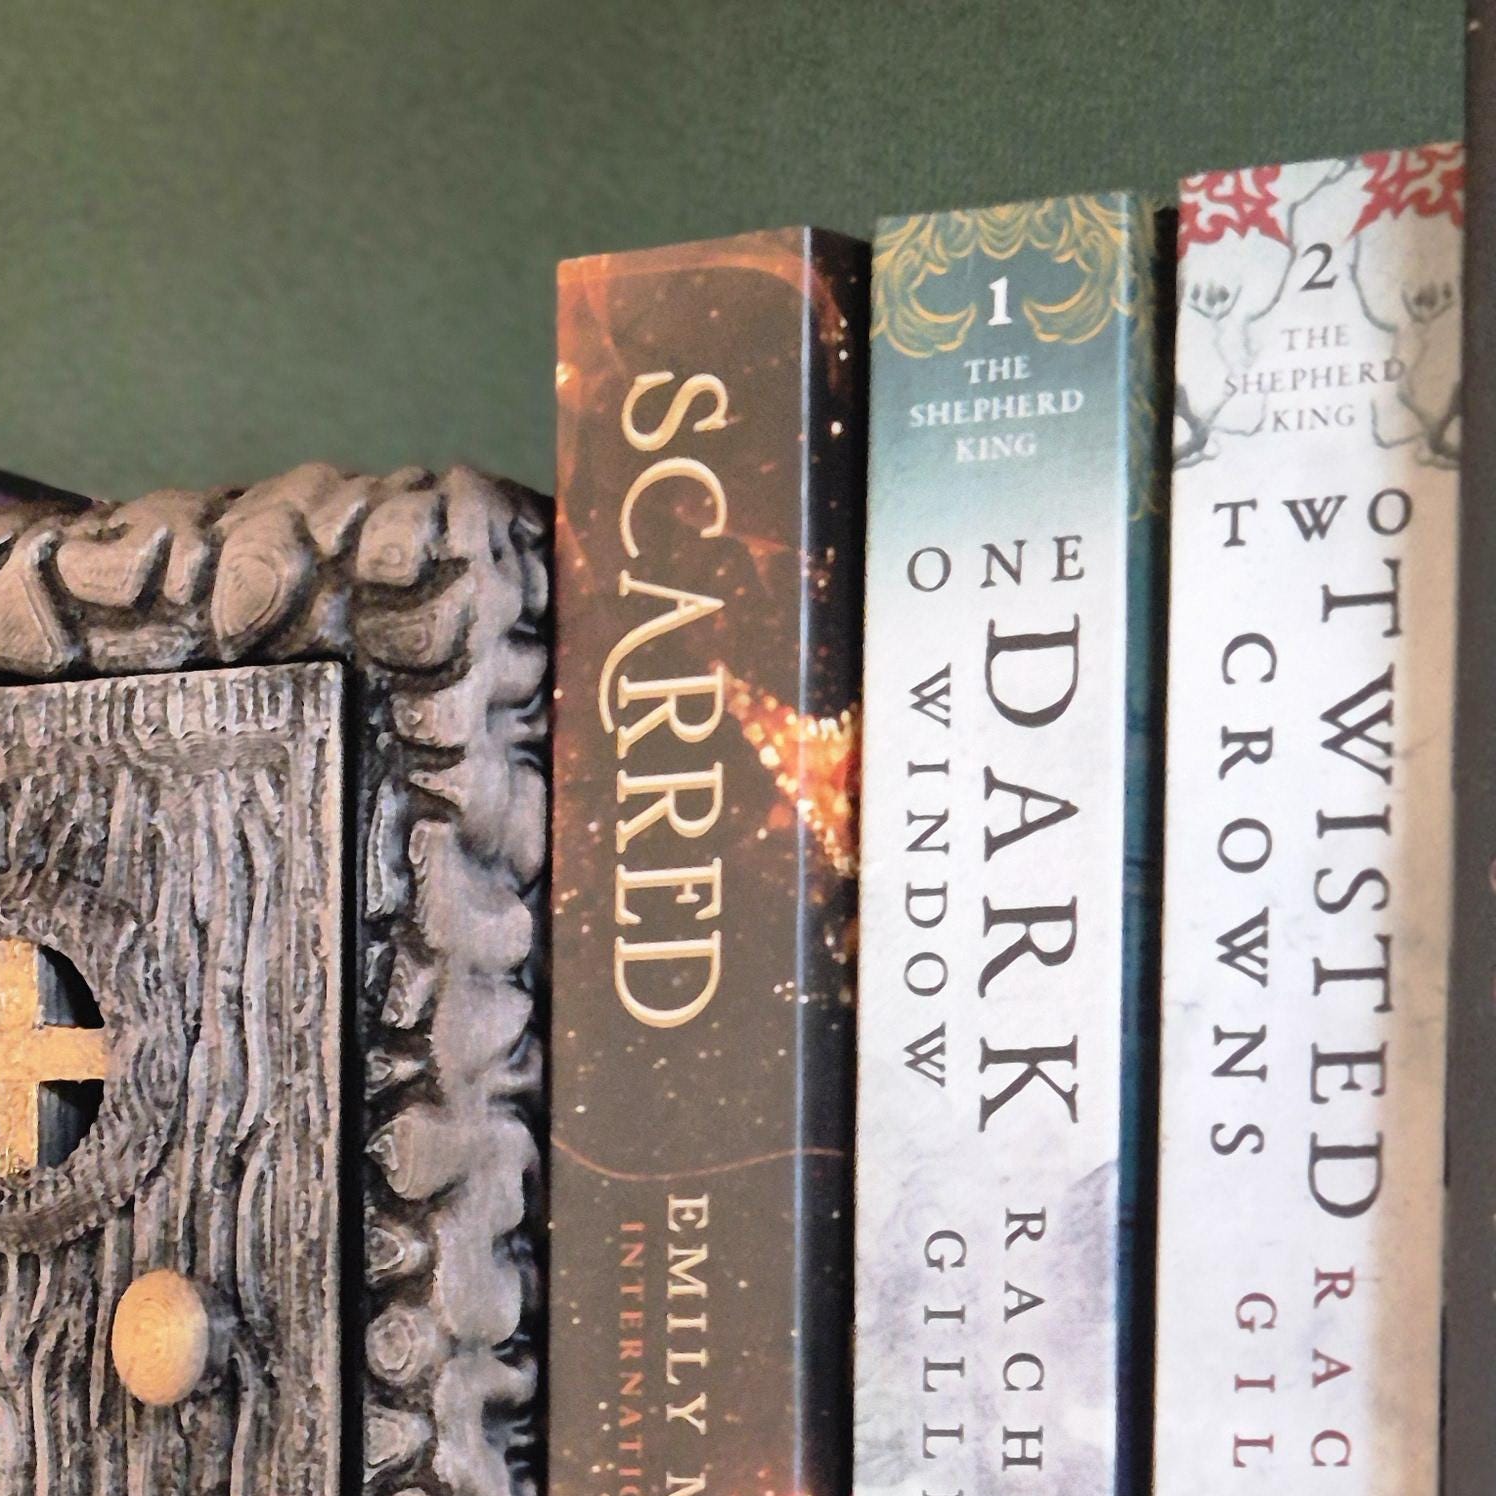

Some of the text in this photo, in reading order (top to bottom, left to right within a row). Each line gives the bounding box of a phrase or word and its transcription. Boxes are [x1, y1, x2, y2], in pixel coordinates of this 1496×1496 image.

[1300, 243, 1338, 292] 2
[988, 275, 1012, 326] 1
[1281, 324, 1351, 351] THE
[964, 355, 1033, 387] THE
[1224, 357, 1405, 396] SHEPHERD
[909, 389, 1084, 429] SHEPHERD
[1271, 404, 1356, 433] KING
[954, 433, 1038, 464] KING
[1213, 489, 1413, 547] TWO
[906, 534, 1085, 593] ONE
[598, 371, 729, 1028] SCARRED
[903, 662, 952, 1087] WINDOW
[978, 612, 1080, 1132] DARK
[1209, 632, 1277, 1156] CROWNS
[1307, 557, 1403, 1219] TWISTED
[666, 1193, 710, 1435] EMILY
